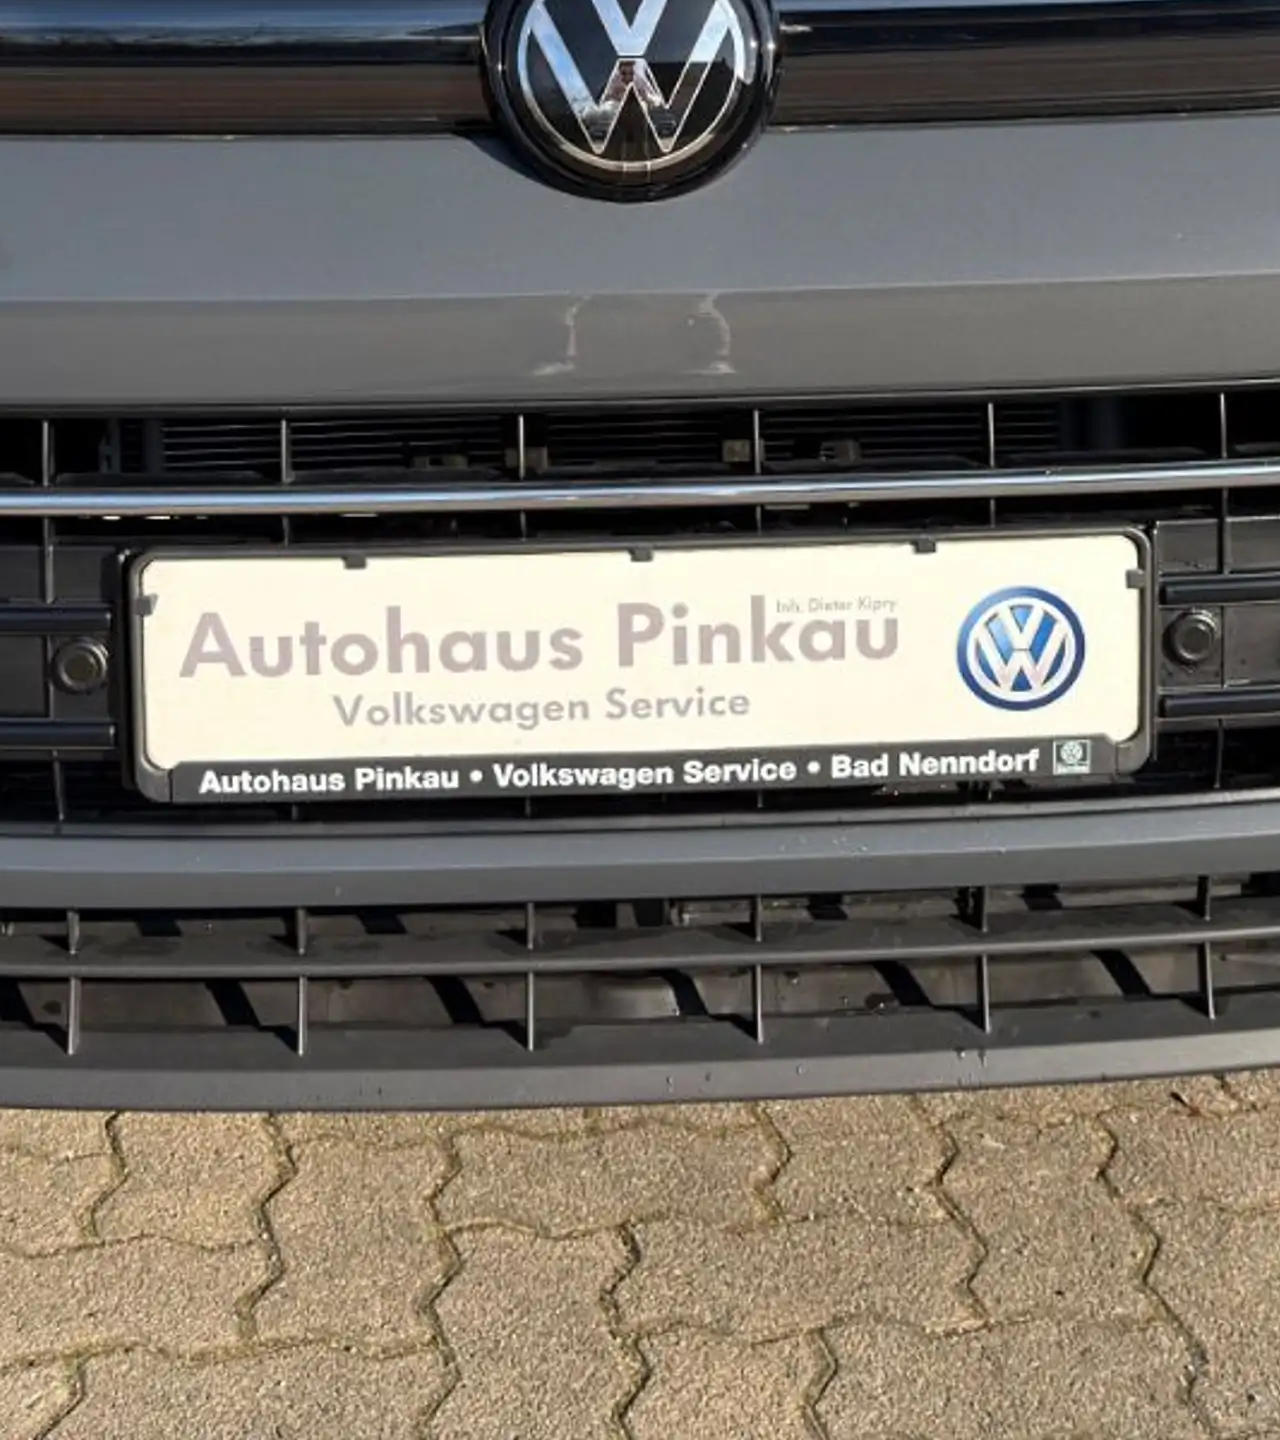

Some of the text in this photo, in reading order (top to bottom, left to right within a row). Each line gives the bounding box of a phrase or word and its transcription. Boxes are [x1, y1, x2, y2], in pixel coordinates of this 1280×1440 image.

[179, 594, 899, 678] Autohaus Pinkau
[332, 686, 751, 731] Volkswagen Service
[198, 767, 346, 794] Autohaus
[354, 764, 460, 791] Pinkau
[491, 762, 674, 791] Volkswagen
[683, 757, 797, 784] Service
[830, 752, 890, 779] Bad
[898, 747, 1041, 777] Nenndorf
